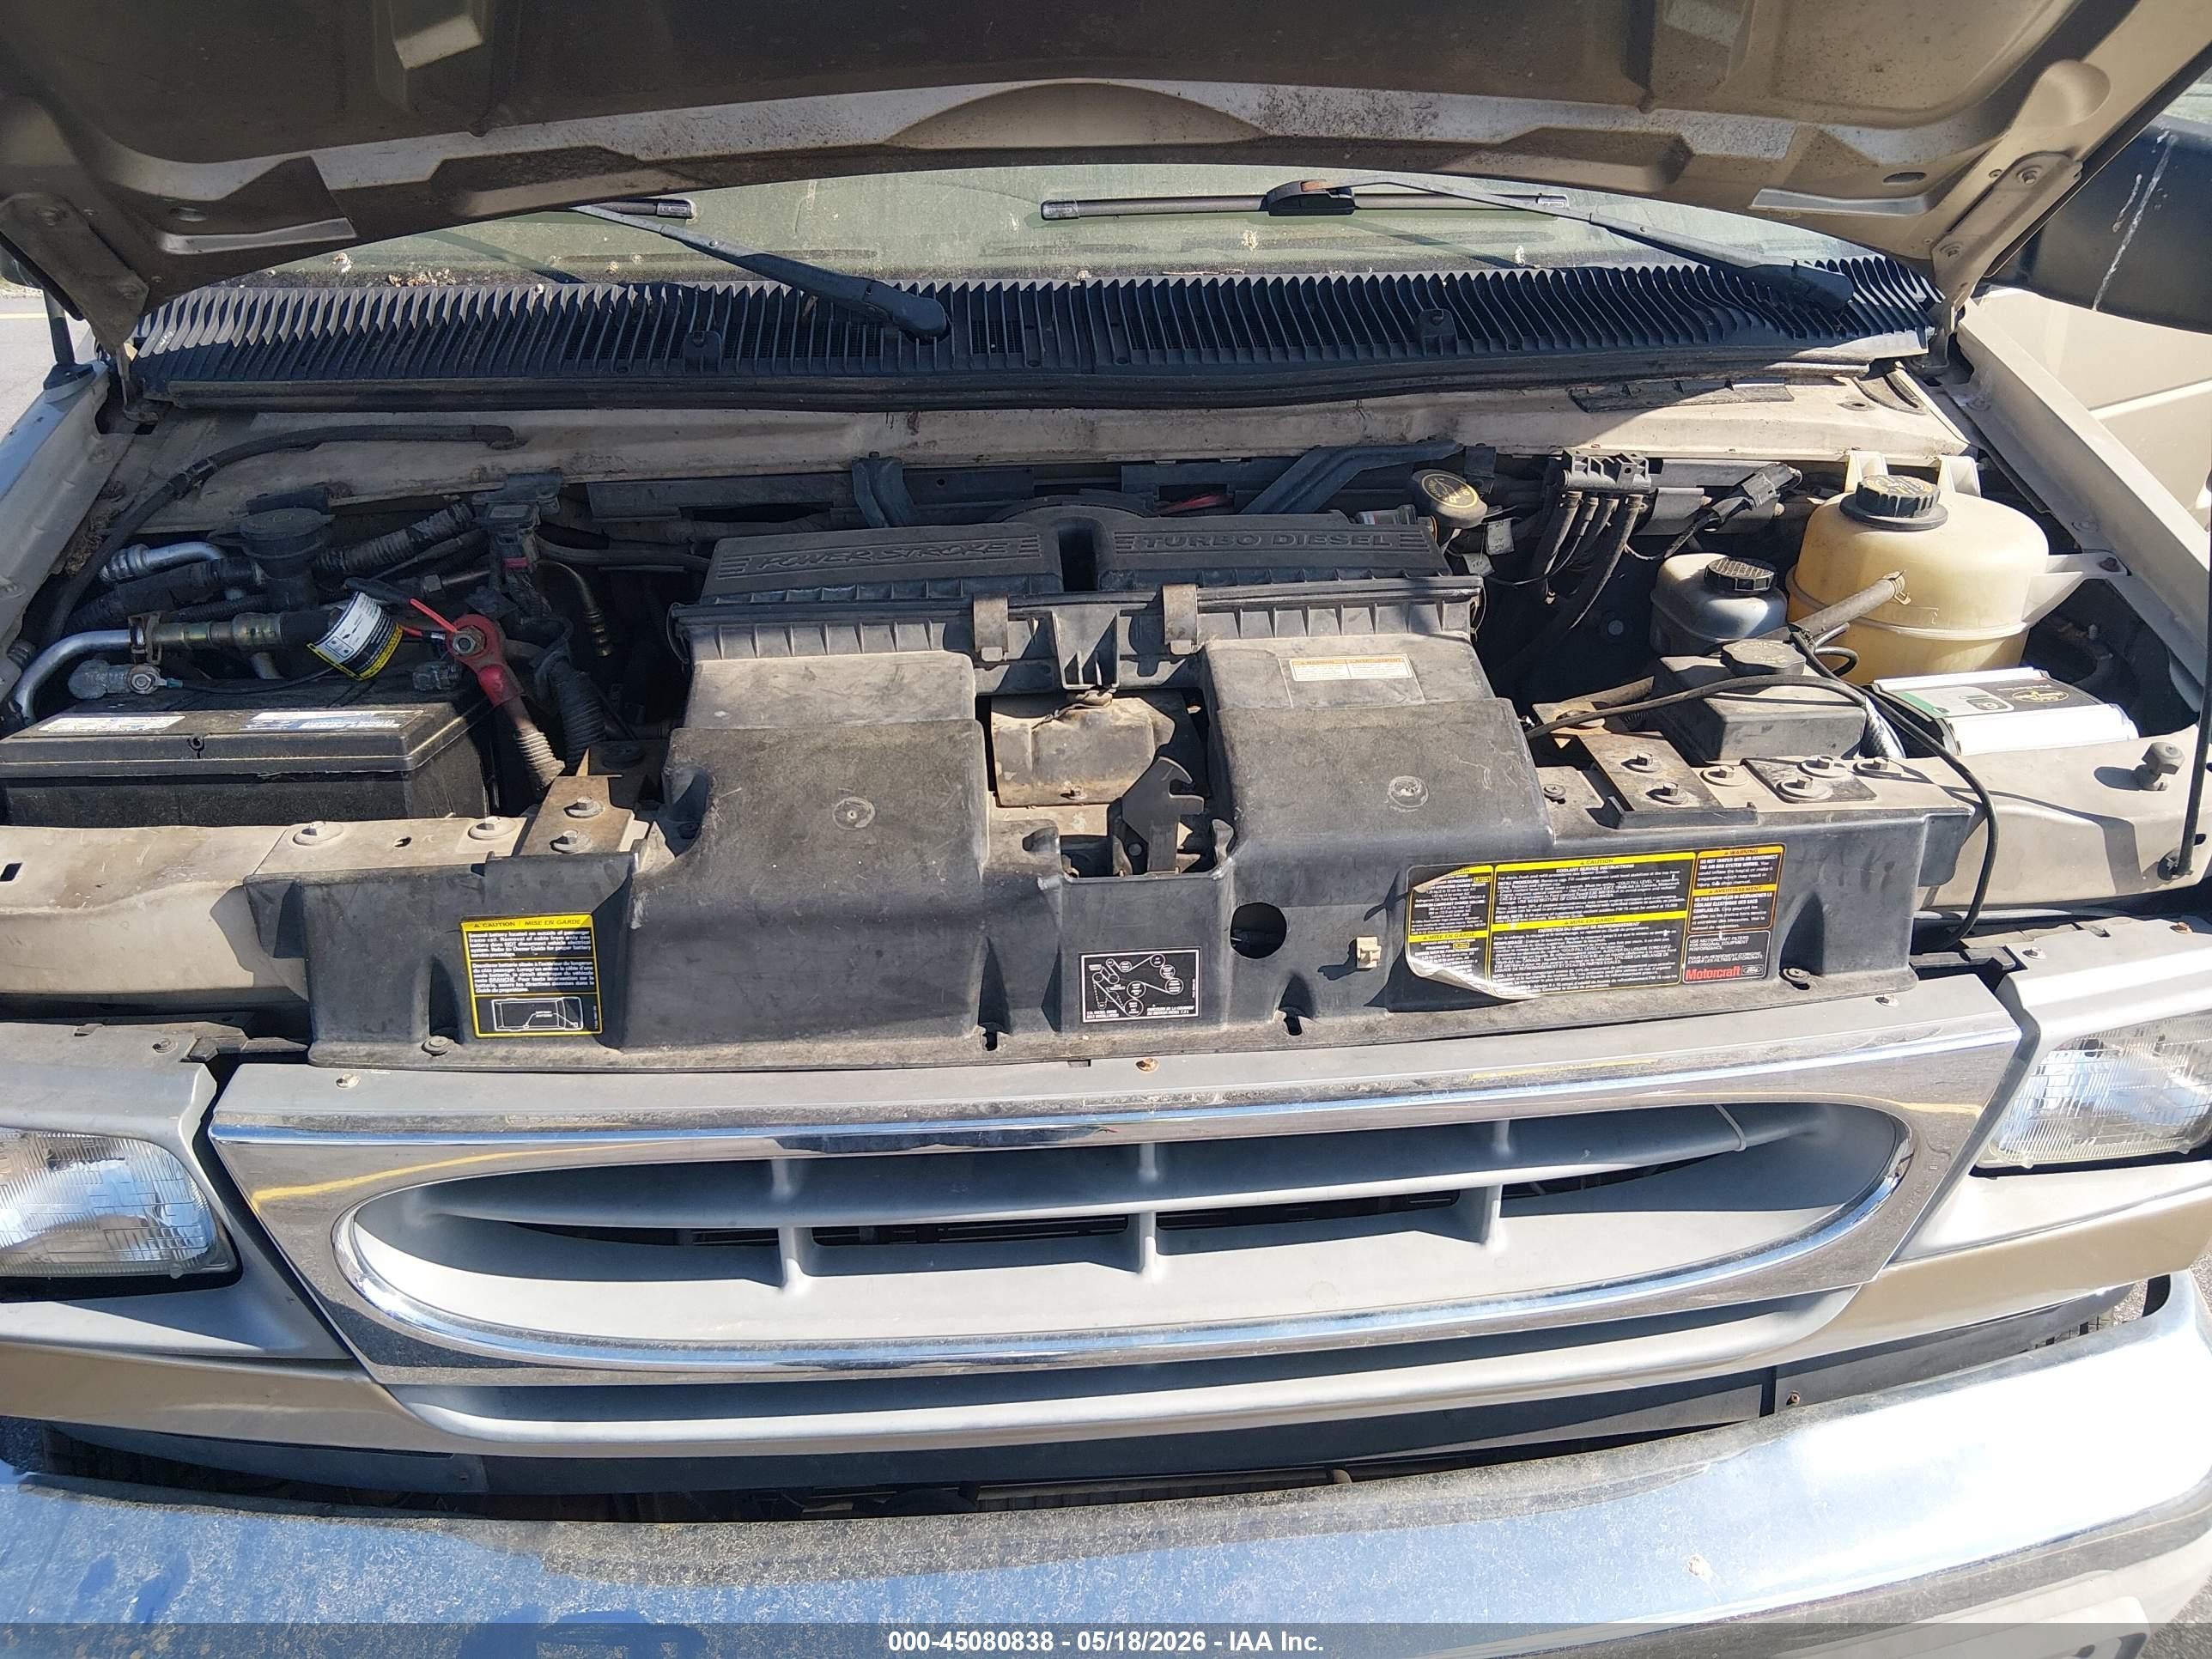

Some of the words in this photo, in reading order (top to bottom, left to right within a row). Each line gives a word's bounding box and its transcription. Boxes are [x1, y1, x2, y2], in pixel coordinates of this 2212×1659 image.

[1143, 534, 1261, 548] TURBO
[1272, 534, 1393, 547] DIESEL
[759, 550, 872, 570] POWER
[877, 542, 1010, 561] STROKE
[1685, 965, 1741, 980] Motorcraft
